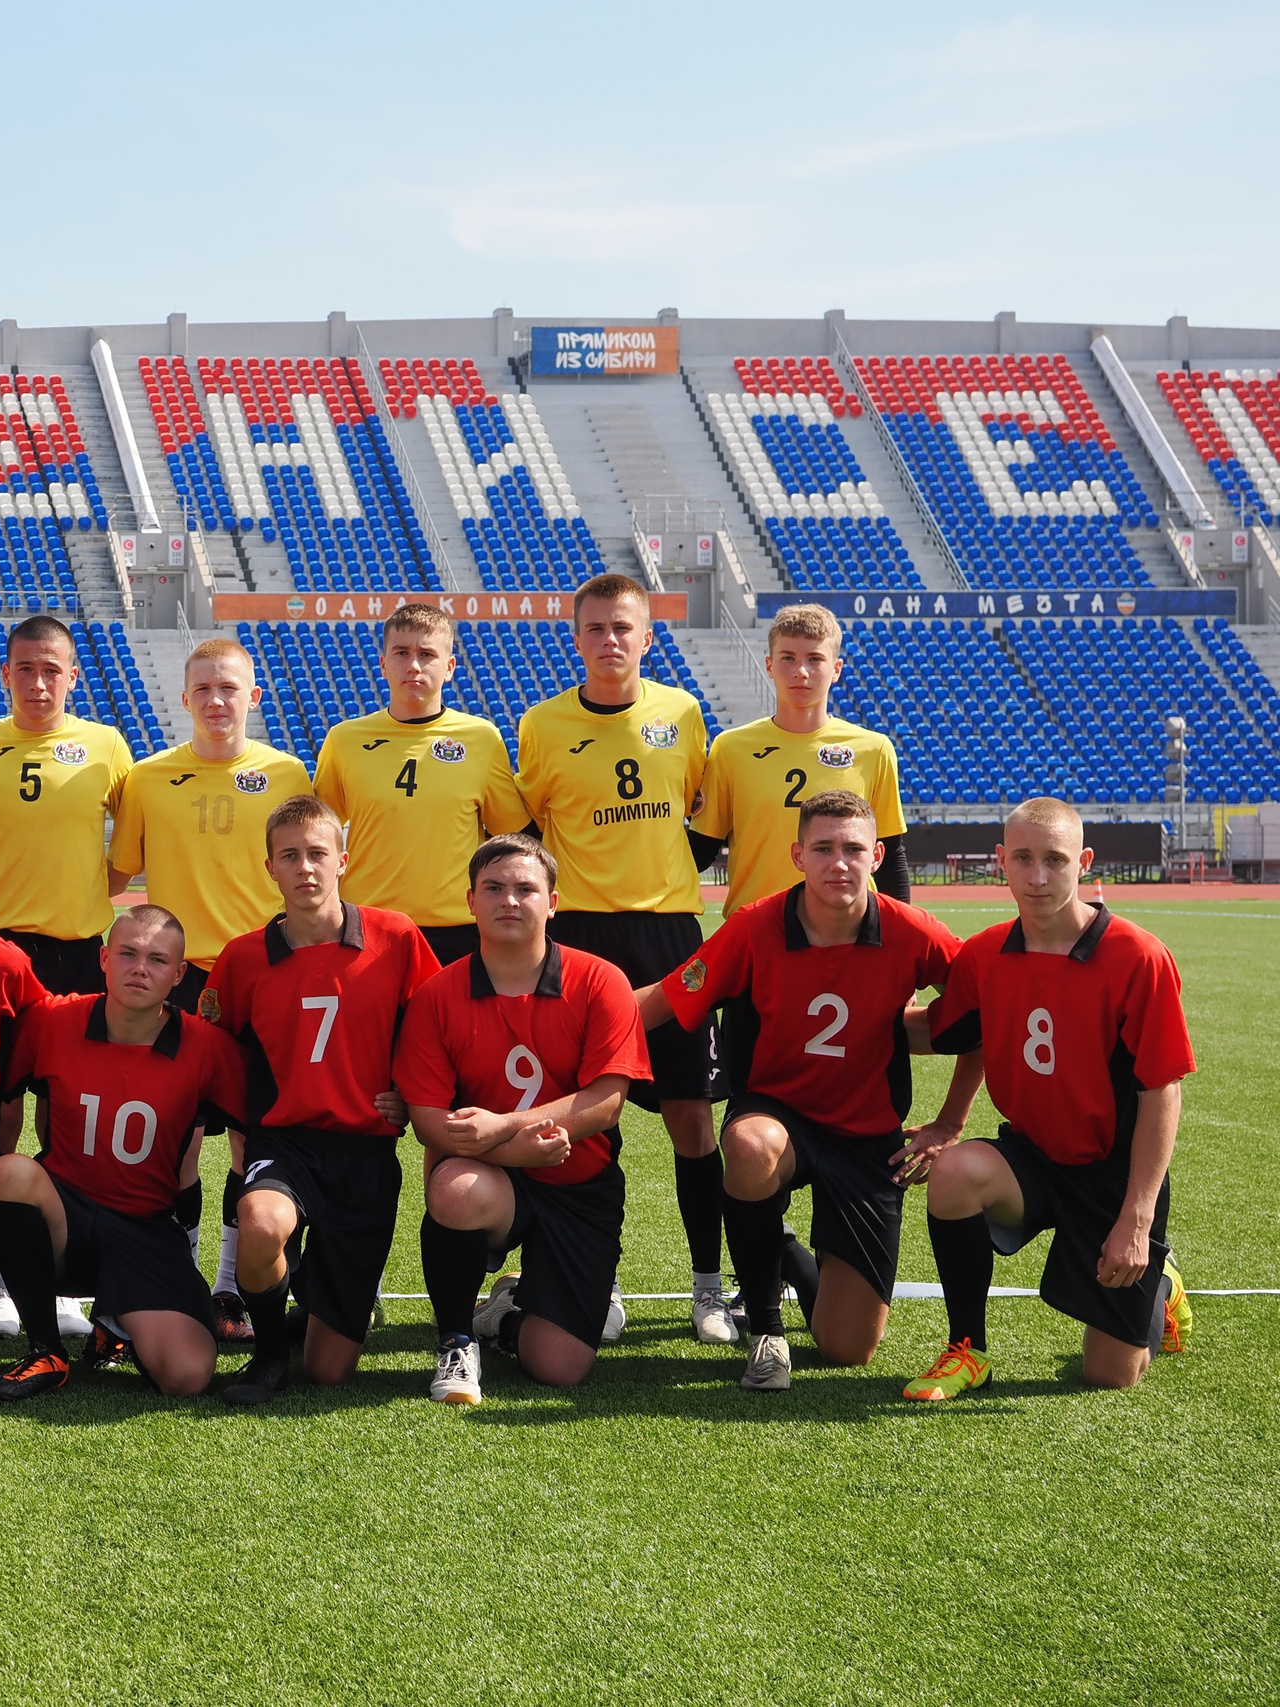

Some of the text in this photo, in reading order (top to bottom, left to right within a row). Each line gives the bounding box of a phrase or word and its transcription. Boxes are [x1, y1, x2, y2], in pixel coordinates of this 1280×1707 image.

[555, 351, 656, 369] ИЗ СИБИРИ
[557, 332, 656, 349] ПРЯМИКОМ
[438, 596, 574, 617] КОМАН
[853, 594, 947, 617] ОДНА
[19, 762, 42, 803] 5
[394, 758, 418, 798] 4
[614, 758, 643, 800] 8
[784, 768, 807, 808] 2
[191, 793, 235, 836] 10
[593, 802, 671, 827] ОЛИМПИЯ
[301, 995, 339, 1063] 7
[807, 993, 849, 1058] 2
[1023, 1007, 1055, 1075] 8
[504, 1044, 544, 1112] 9
[79, 1093, 157, 1165] 10
